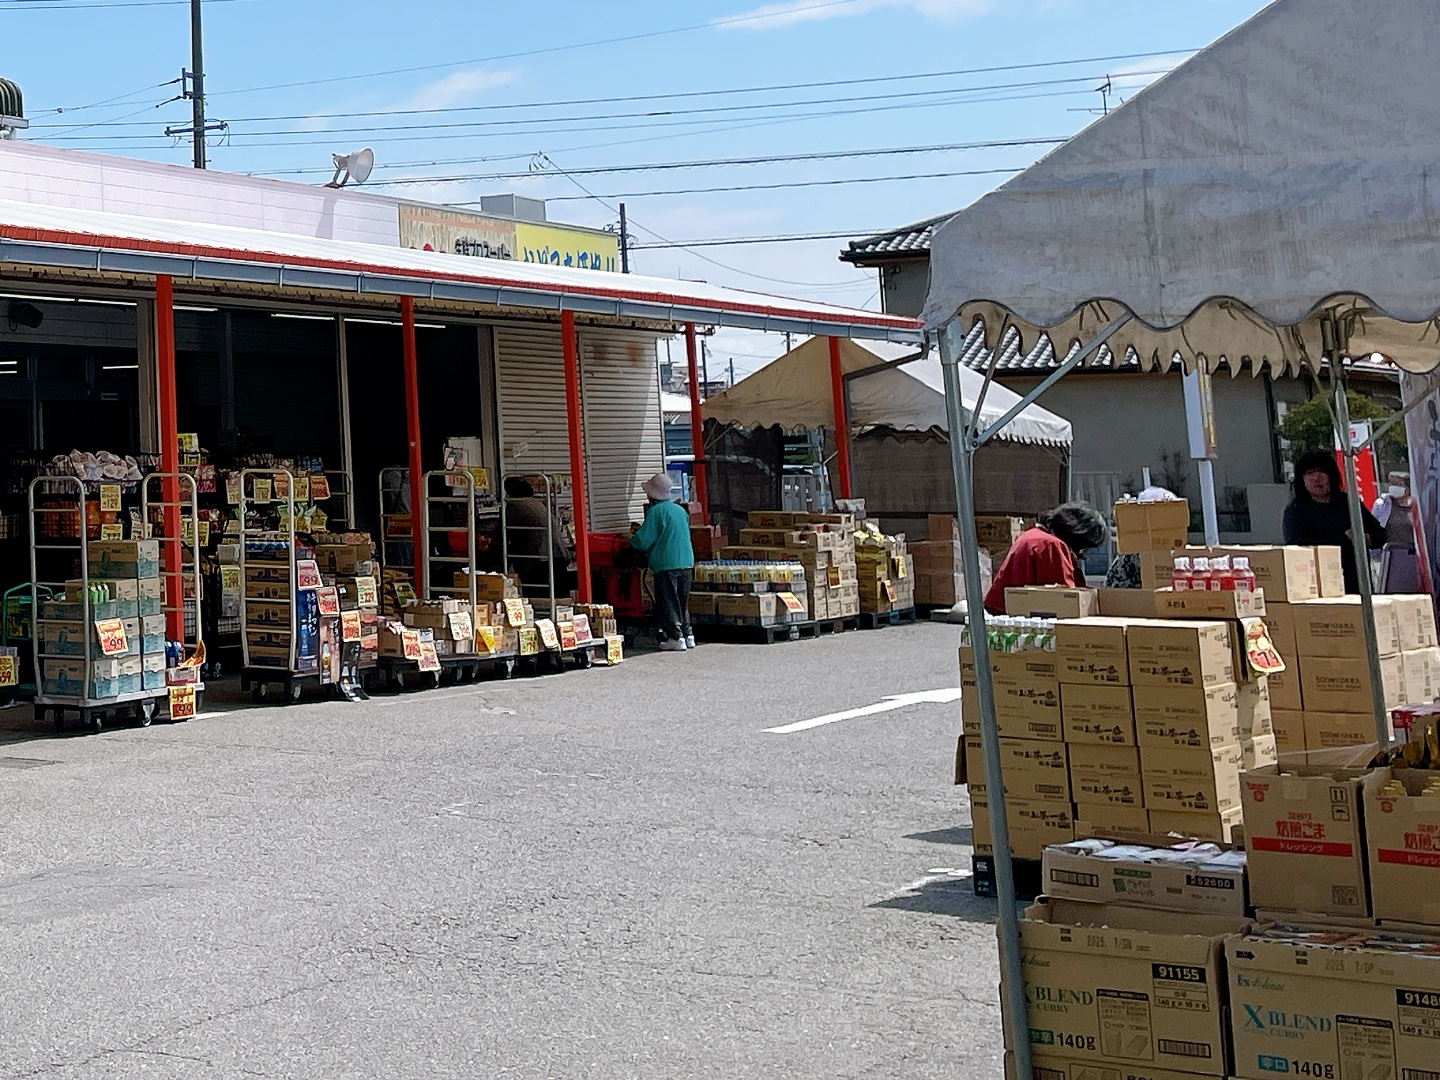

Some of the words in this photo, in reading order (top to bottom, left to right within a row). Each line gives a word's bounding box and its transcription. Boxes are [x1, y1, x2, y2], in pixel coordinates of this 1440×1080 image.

[1279, 842, 1324, 852] ドレッシング
[1158, 966, 1200, 981] 91155
[1035, 986, 1094, 1006] BLEND
[1404, 992, 1440, 1007] 9148
[1242, 1003, 1266, 1029] X
[1268, 1010, 1332, 1033] BLEND
[1056, 1032, 1097, 1051] 140g
[1291, 1060, 1335, 1080] 140g
